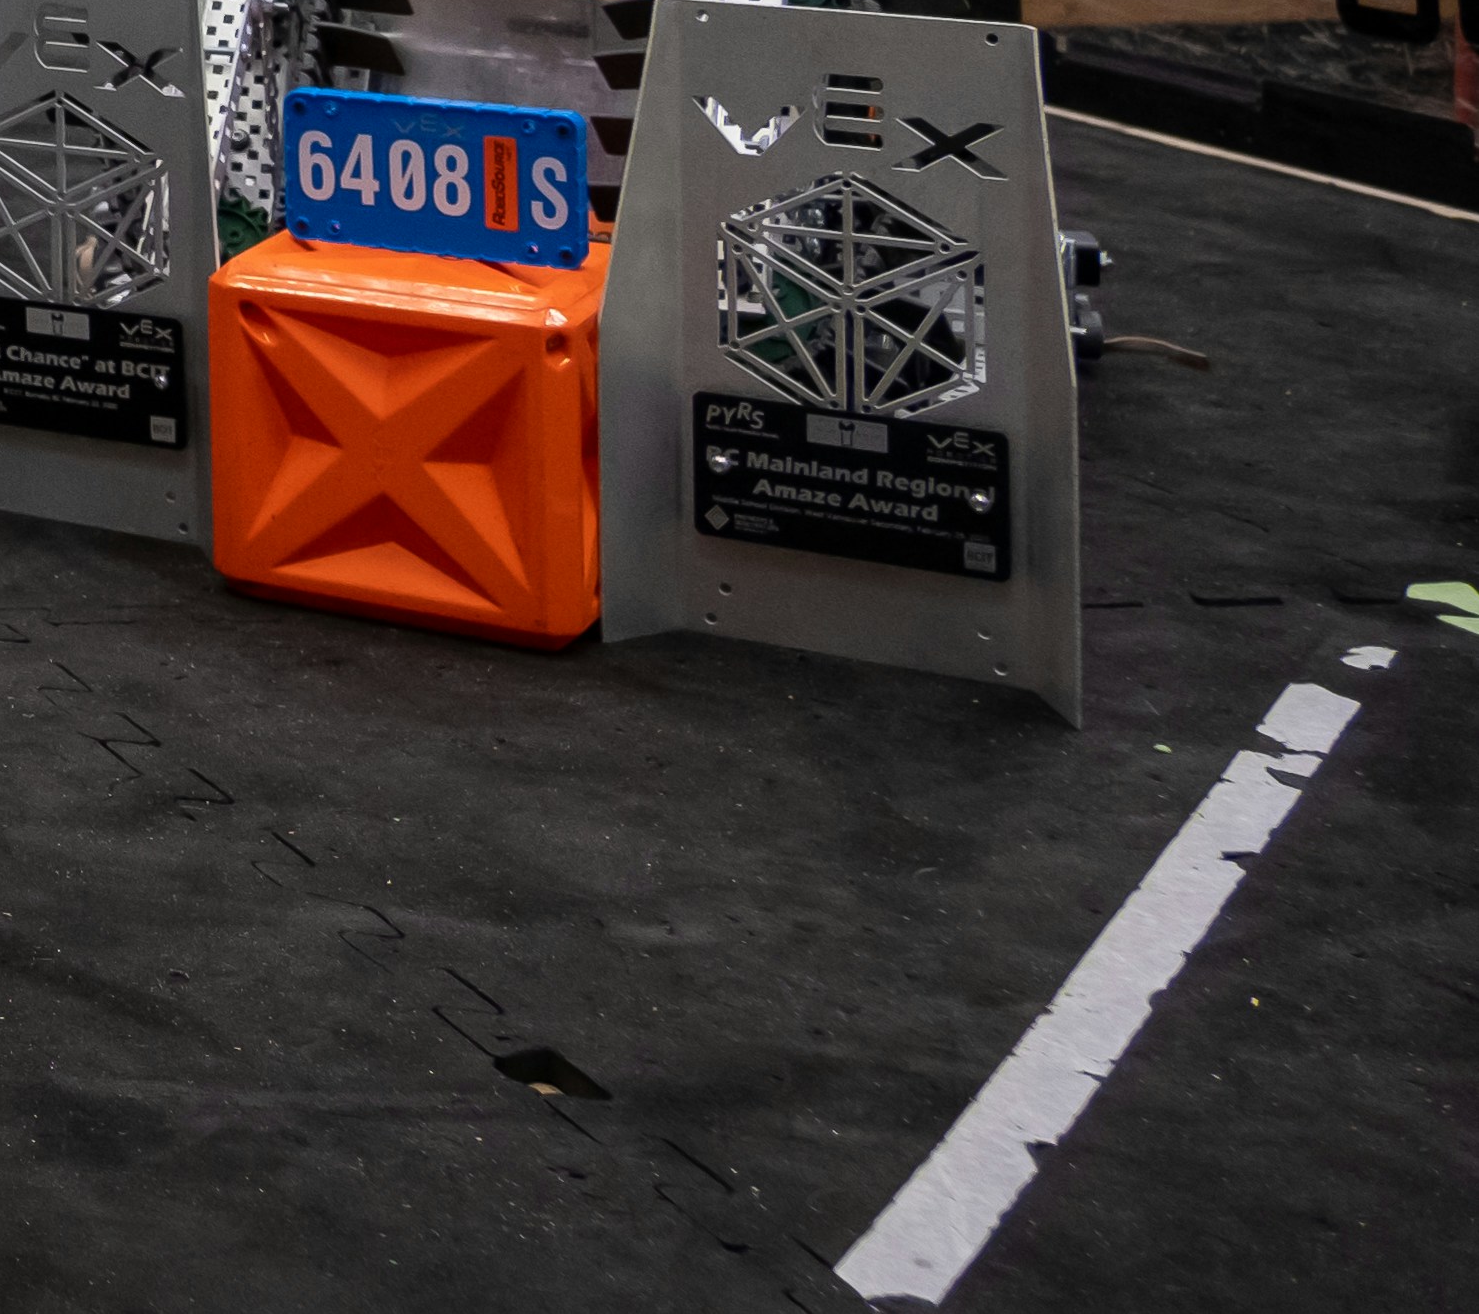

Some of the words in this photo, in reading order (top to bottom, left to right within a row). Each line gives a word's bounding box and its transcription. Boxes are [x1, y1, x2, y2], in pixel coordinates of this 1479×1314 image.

[393, 112, 464, 139] VEX
[692, 73, 1010, 181] VEX
[298, 129, 472, 217] 6408
[530, 156, 569, 230] S
[120, 320, 173, 340] VEX
[6, 345, 89, 369] Chance"
[94, 357, 116, 374] at
[60, 376, 131, 399] Award
[706, 402, 765, 430] PYRS
[927, 431, 996, 457] VEX
[747, 451, 869, 485] Mainland
[876, 470, 996, 504] Regionl
[752, 478, 842, 508] Amaze
[848, 493, 940, 522] Award
